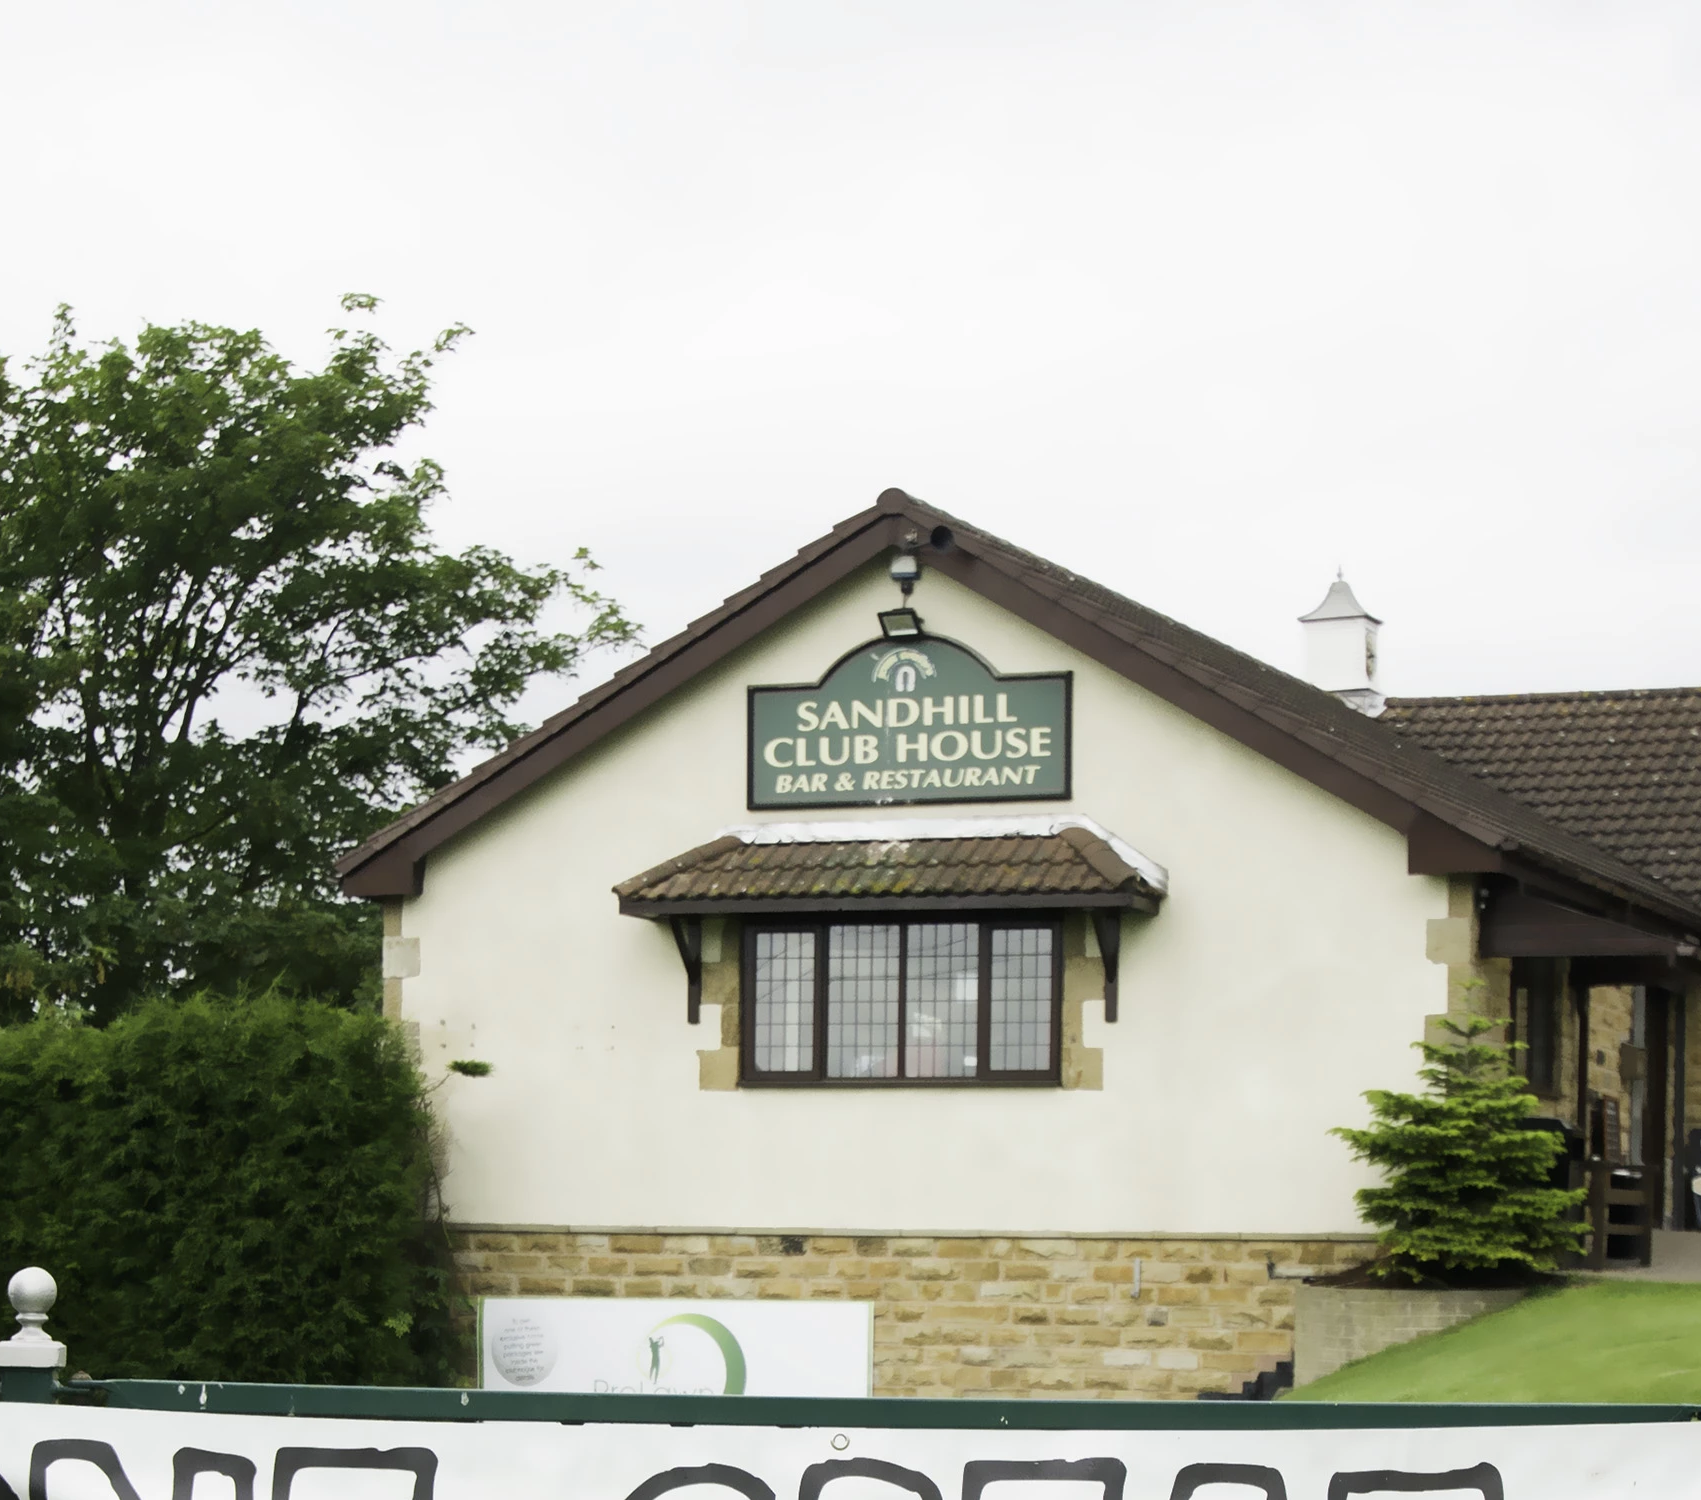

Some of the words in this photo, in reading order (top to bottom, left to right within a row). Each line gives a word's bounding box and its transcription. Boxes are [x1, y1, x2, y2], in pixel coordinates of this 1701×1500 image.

[796, 693, 1018, 731] SANDHILL
[763, 735, 879, 768] CLUB
[896, 727, 1052, 763] HOUSE
[775, 772, 827, 793] BAR
[834, 771, 856, 791] &
[863, 765, 1041, 790] RESTAURANT
